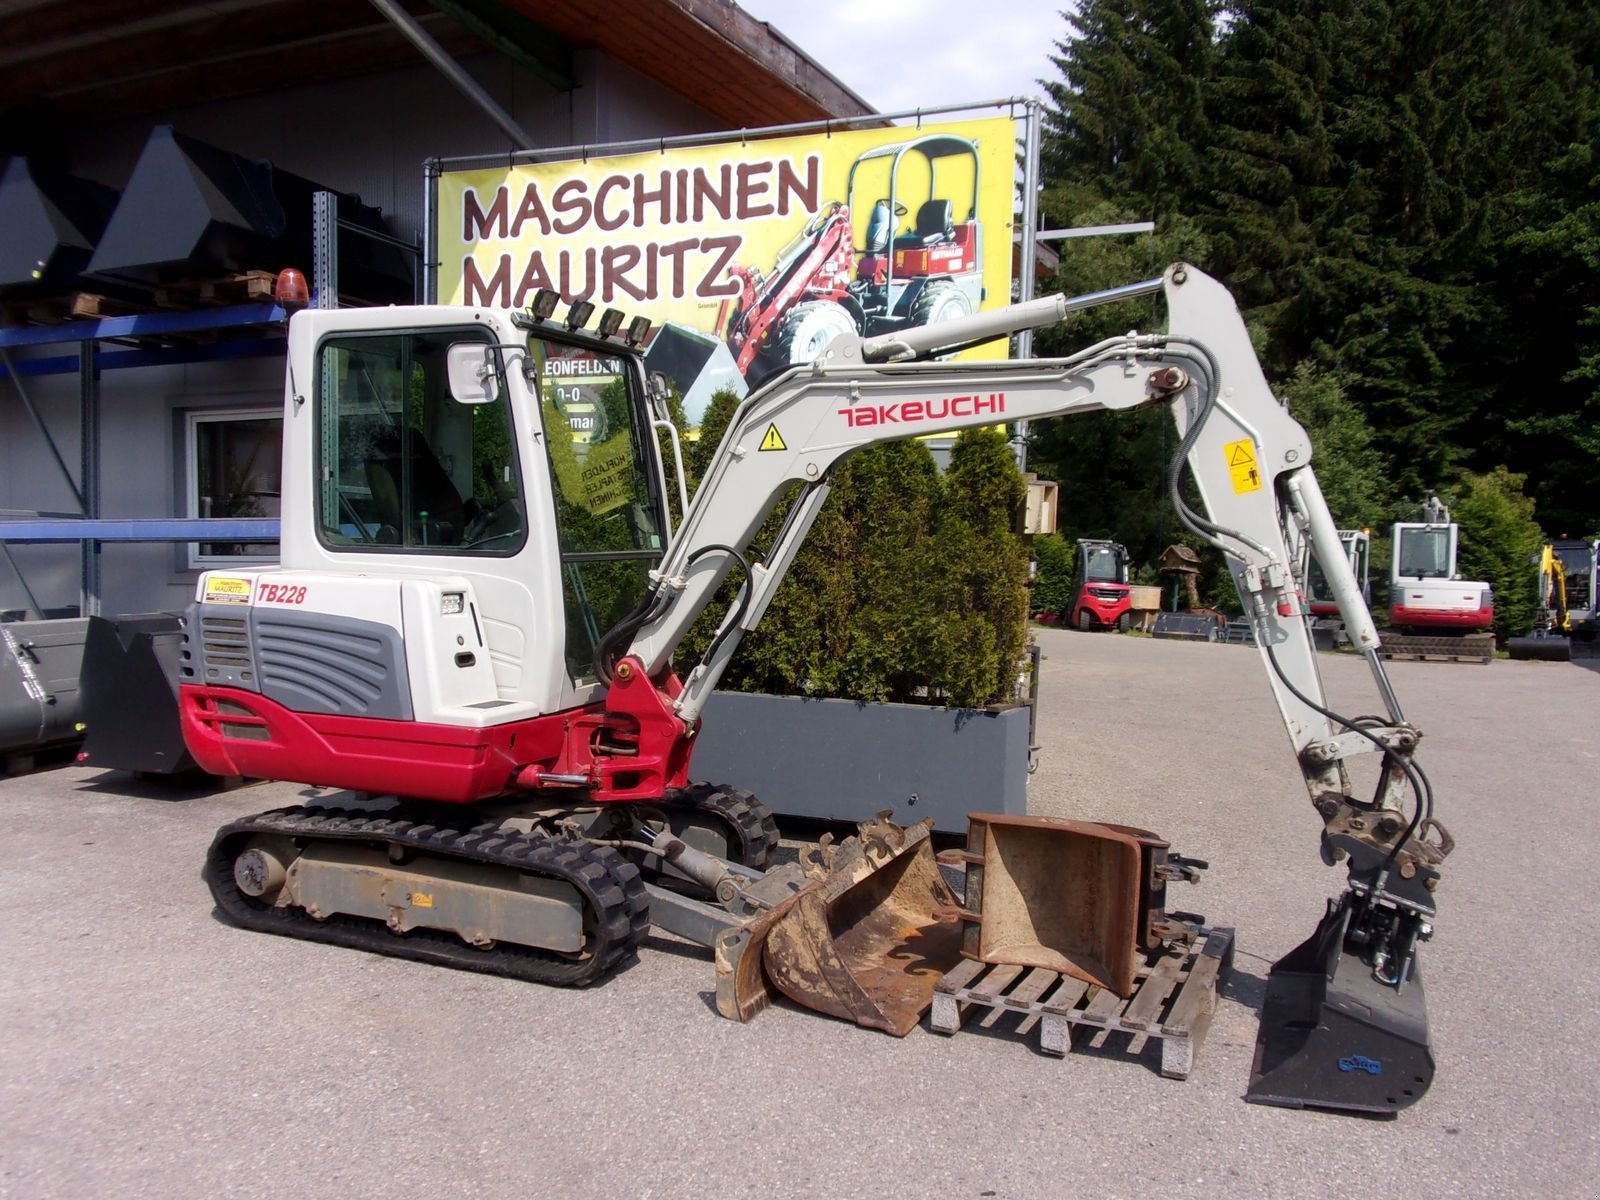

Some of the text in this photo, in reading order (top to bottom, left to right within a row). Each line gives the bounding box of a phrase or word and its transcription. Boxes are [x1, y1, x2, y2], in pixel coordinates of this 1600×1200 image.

[463, 156, 818, 241] MASCHINEN
[463, 235, 742, 308] MAURITZ
[258, 583, 307, 604] TB228
